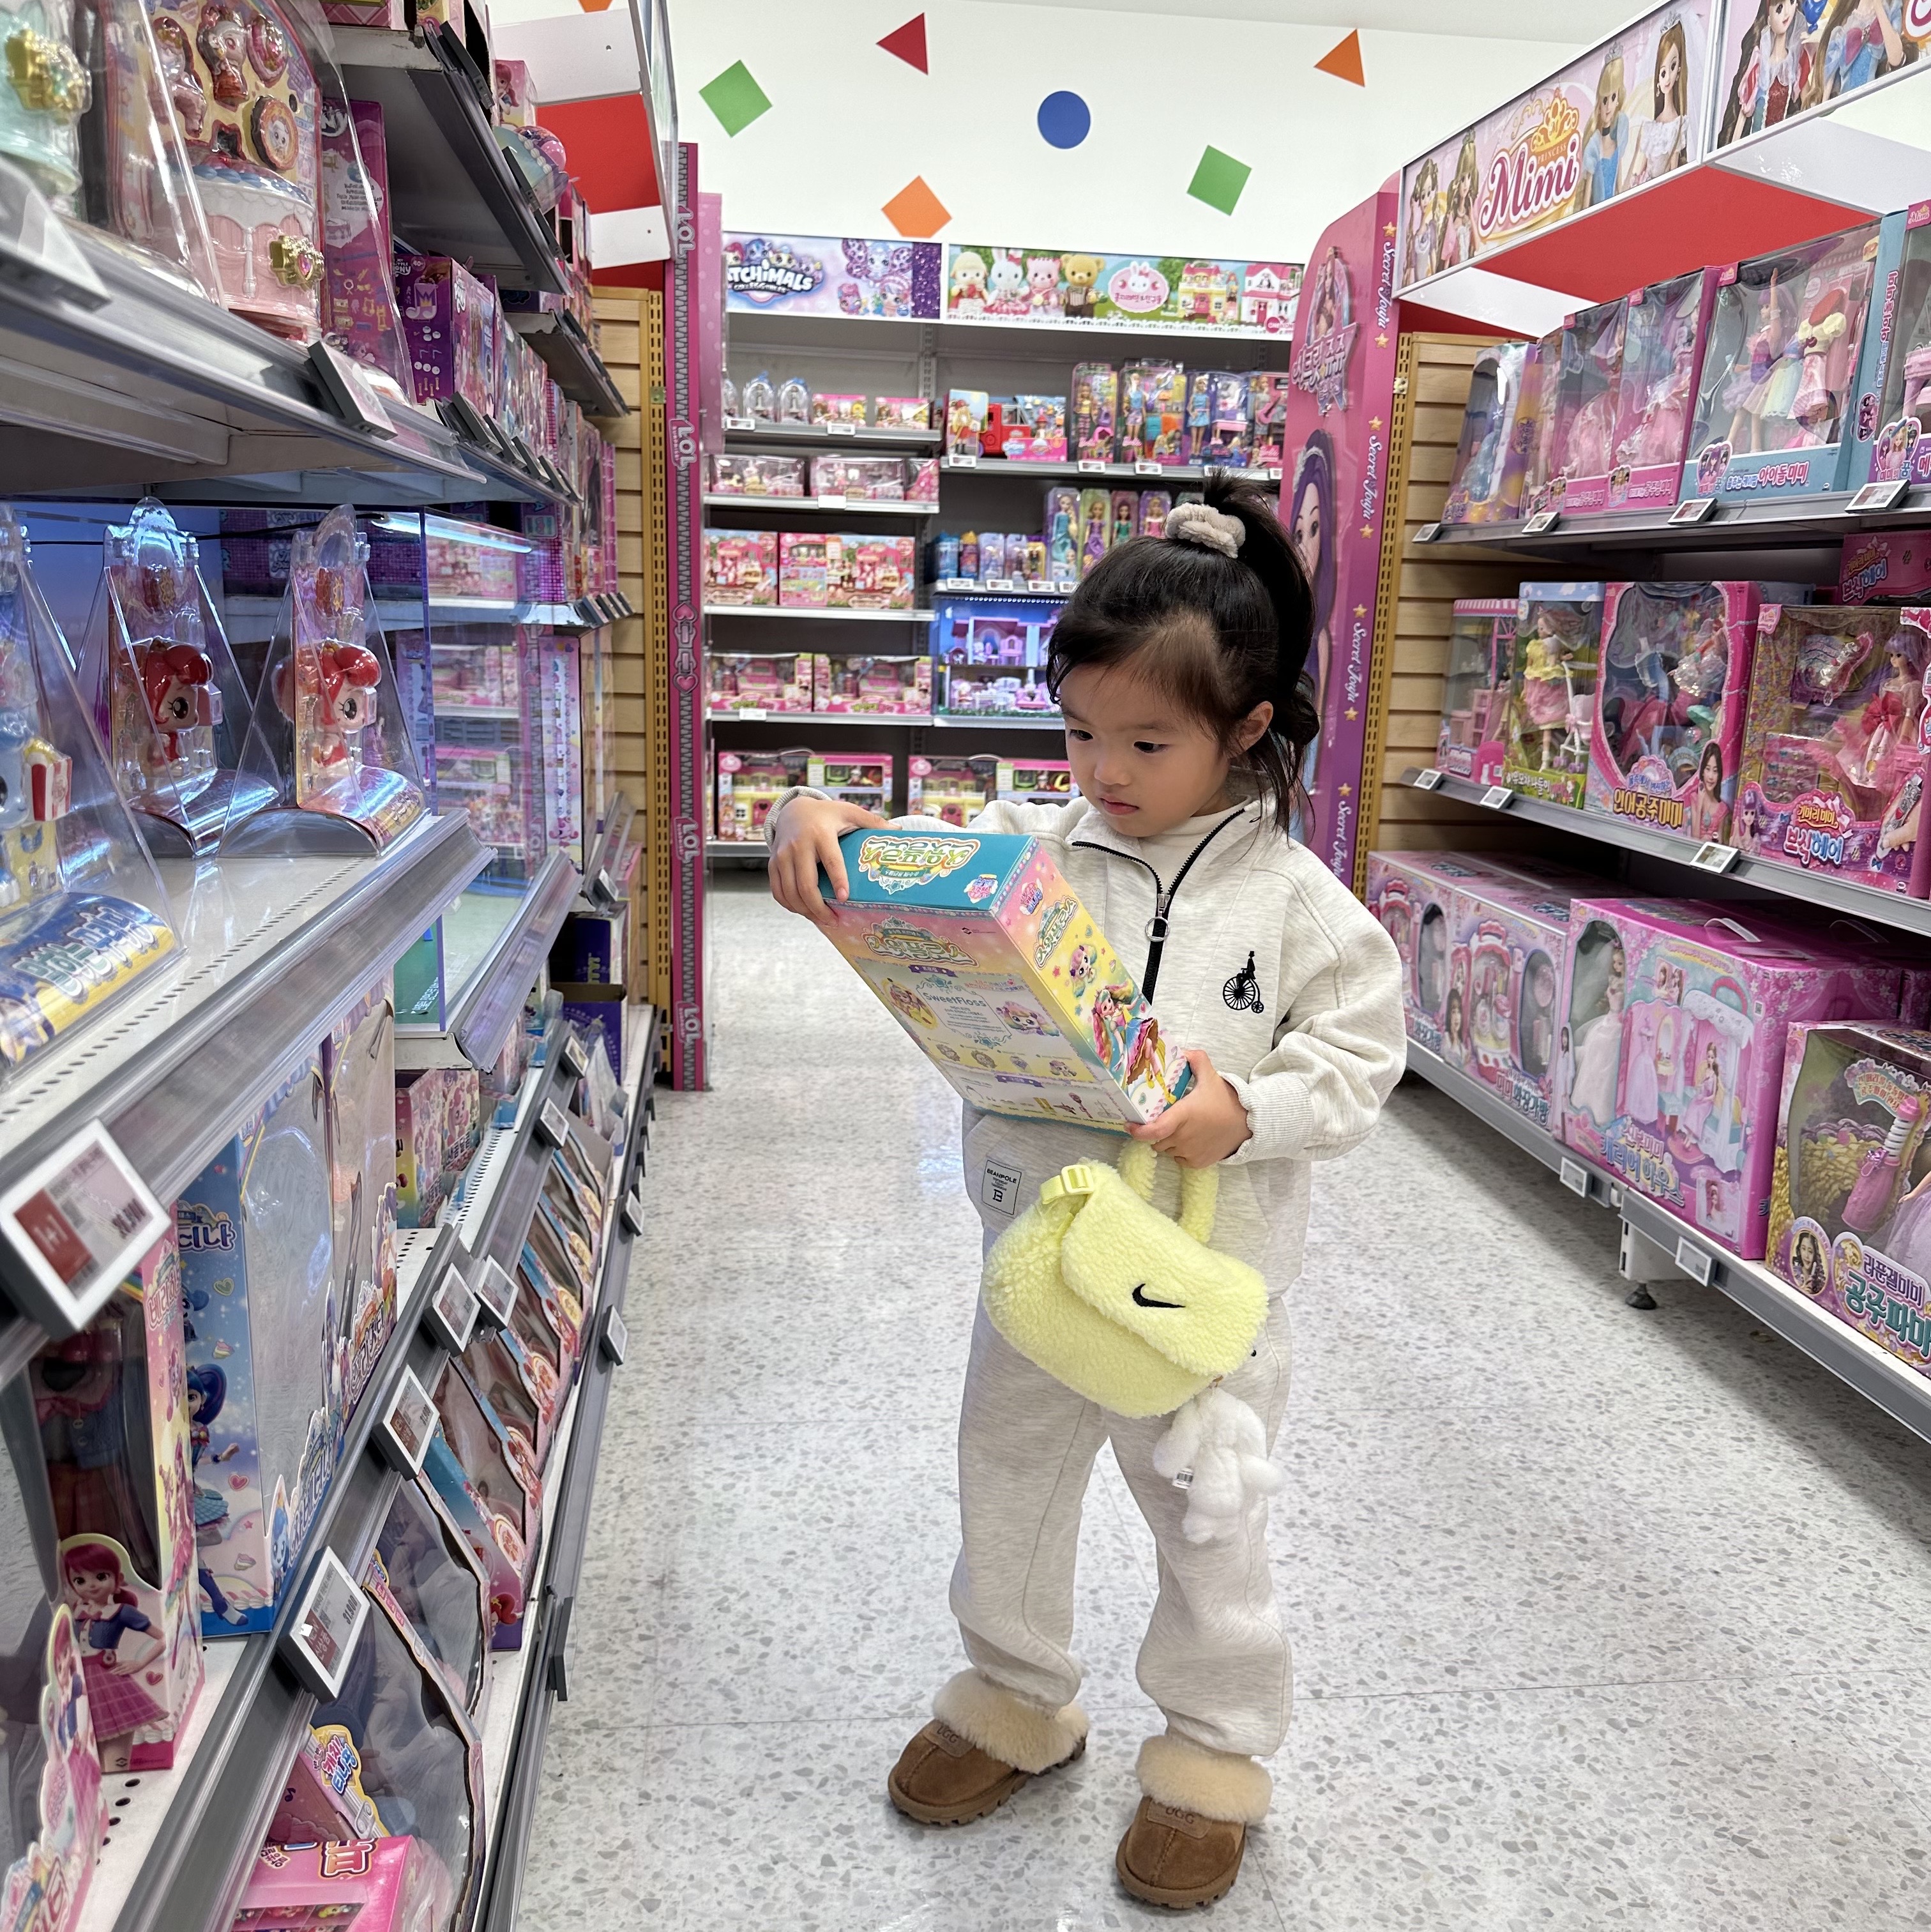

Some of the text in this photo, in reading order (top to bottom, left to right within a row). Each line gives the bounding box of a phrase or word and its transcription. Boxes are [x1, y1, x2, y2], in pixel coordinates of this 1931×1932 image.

[1537, 142, 1568, 164] PRINCESS
[1479, 136, 1579, 232] Mimi
[1375, 241, 1395, 329] Secret Jouju
[678, 425, 697, 470] LOL
[1359, 436, 1382, 520] Secret Jouju
[1757, 460, 1810, 487] 아이돌미미
[1900, 460, 1912, 479] 꿈
[1342, 621, 1368, 703] Secret Jouju
[1335, 800, 1352, 844] Secret
[1613, 787, 1685, 830] 인어공주미미
[681, 822, 701, 864] LOL
[861, 838, 974, 867] 스윗플로스
[866, 935, 974, 964] 스윗플로스
[1036, 901, 1077, 966] 스윗플로스
[11, 941, 112, 998] 말하는
[922, 992, 987, 1007] SweetFloss
[682, 1005, 702, 1041] LOL
[1496, 1070, 1513, 1103] 미미
[1513, 1083, 1550, 1125] 화장가방
[1622, 1123, 1666, 1164] 신부미미
[987, 1168, 1017, 1183] BEANPOLE
[992, 1189, 1003, 1203] B
[1863, 1250, 1924, 1307] 라푼젤미미
[1844, 1270, 1931, 1358] 공주파마
[342, 1595, 358, 1625] 31,900
[314, 1630, 331, 1661] 신상품
[936, 1725, 959, 1745] UGG
[331, 1743, 358, 1794] 티니핑
[1165, 1806, 1196, 1825] UGG
